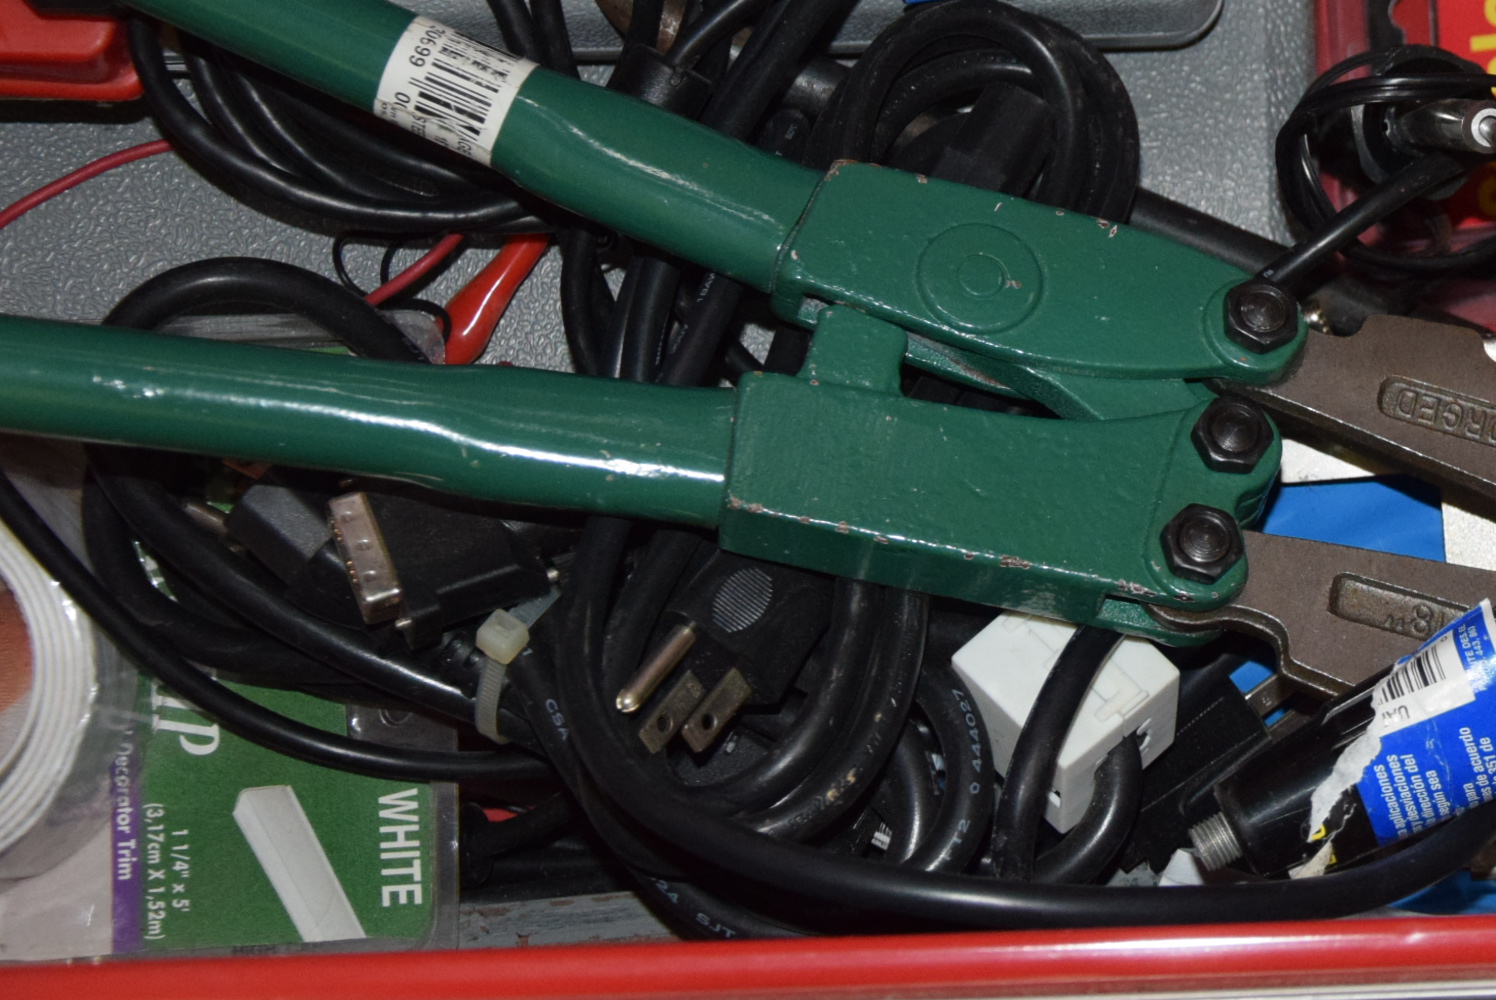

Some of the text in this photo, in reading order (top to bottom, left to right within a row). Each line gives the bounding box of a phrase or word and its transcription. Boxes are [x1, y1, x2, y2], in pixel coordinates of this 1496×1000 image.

[951, 689, 982, 772] 444027
[1480, 737, 1495, 752] de
[1401, 754, 1421, 773] del
[1460, 727, 1481, 774] acuerdo
[1374, 764, 1400, 829] aplicaciones
[1426, 771, 1442, 791] sea
[116, 838, 137, 880] Trim
[170, 844, 190, 878] 1/4"
[377, 788, 423, 908] WHITE
[142, 802, 166, 940] (3,17cm X 1,52m)
[172, 883, 186, 893] x
[696, 913, 736, 938] SJT
